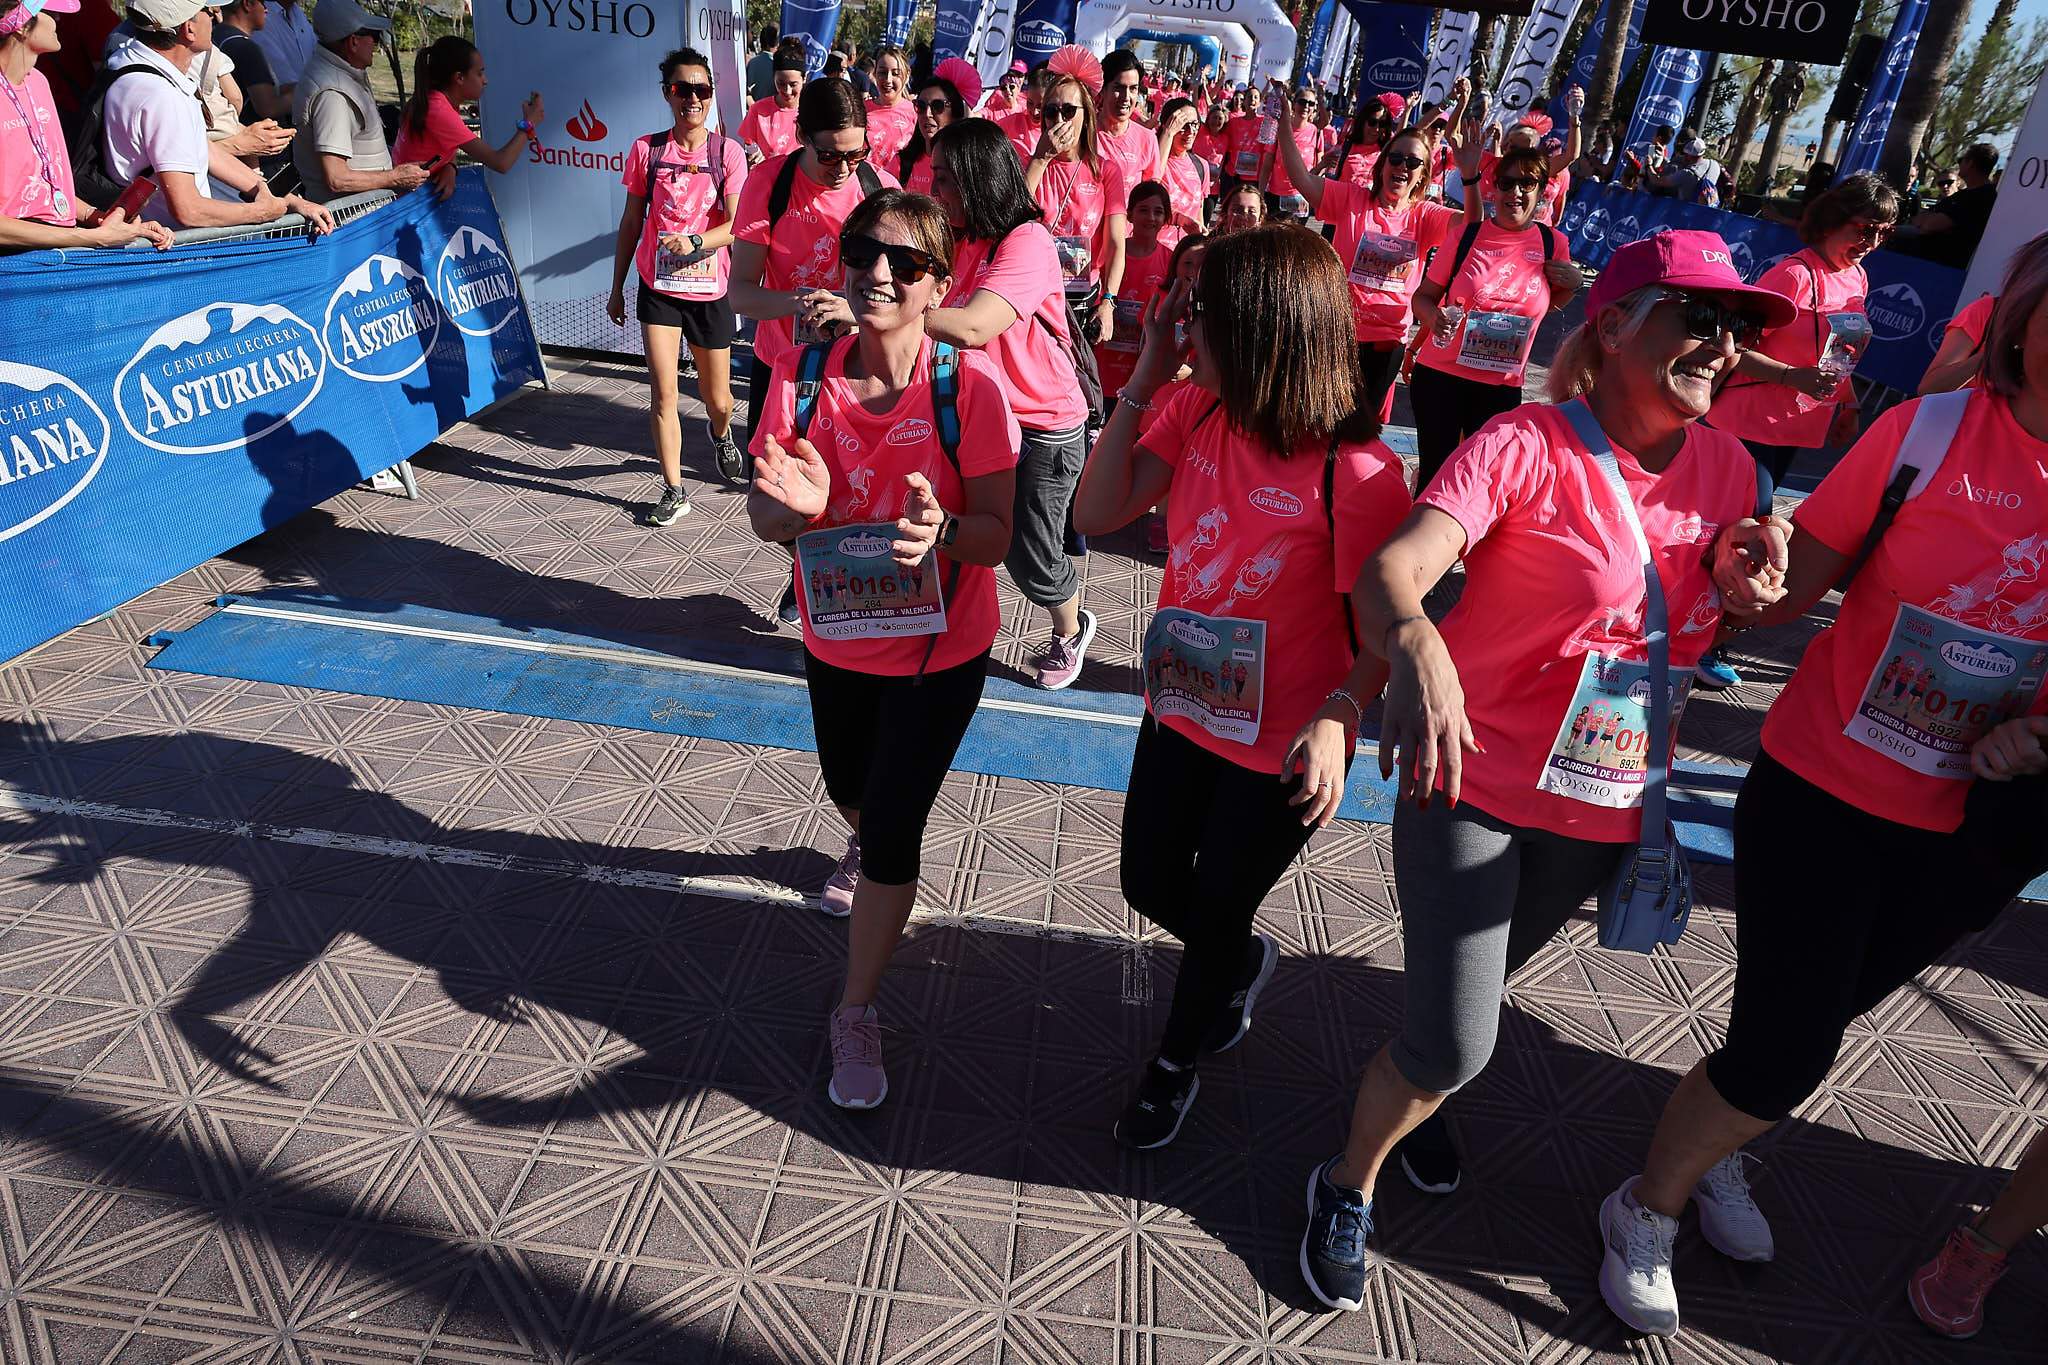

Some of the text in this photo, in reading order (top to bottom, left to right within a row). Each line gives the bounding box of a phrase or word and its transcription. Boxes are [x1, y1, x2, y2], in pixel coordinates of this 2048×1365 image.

[506, 0, 655, 38] OYSHO
[699, 8, 742, 42] OYSHO
[1682, 0, 1826, 33] OYSHO
[339, 299, 436, 364] ASTURIANA
[162, 326, 301, 378] CENTRAL LECHERA
[142, 345, 318, 435] ASTURIANA
[1253, 491, 1299, 513] ASTURIANA
[842, 540, 890, 553] ASTURIANA
[850, 574, 897, 596] 016
[817, 604, 935, 623] CARRERA DE LA MUJER VALENCIA
[864, 599, 882, 609] 284
[826, 620, 931, 636] OYSHO Santander
[1170, 623, 1216, 647] ASTURIANA
[1942, 644, 2012, 676] ASTURIANA
[1175, 659, 1217, 690] 016
[1215, 707, 1251, 720] VALENCIA
[1923, 688, 1991, 725] 016
[1867, 706, 1905, 734] CARRERA
[1906, 727, 1919, 739] DE
[1919, 733, 1932, 746] LA
[1927, 721, 1962, 740] 8922
[1867, 726, 1917, 758] OYSHO
[1557, 758, 1598, 777] CARRERA
[1599, 767, 1611, 779] DE
[1612, 770, 1622, 781] LA
[1619, 758, 1640, 770] 8921
[1559, 776, 1611, 798] OYSHO
